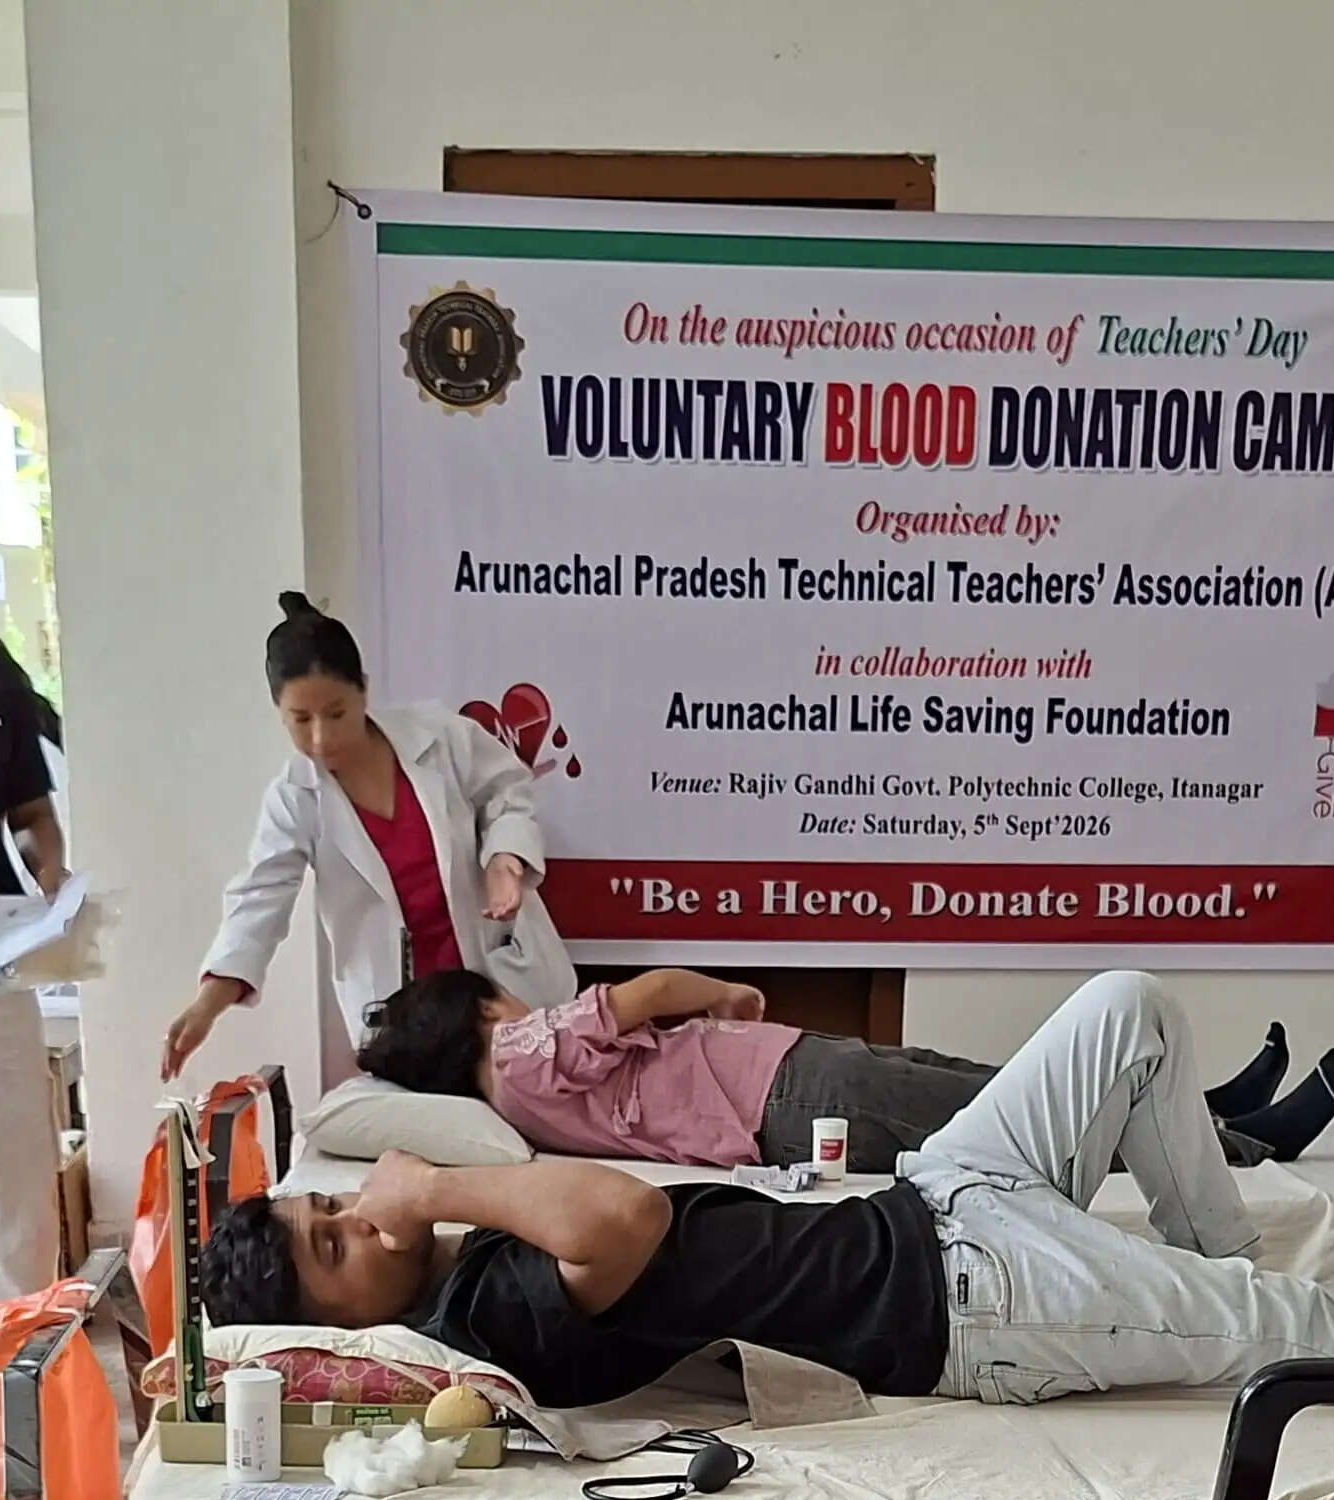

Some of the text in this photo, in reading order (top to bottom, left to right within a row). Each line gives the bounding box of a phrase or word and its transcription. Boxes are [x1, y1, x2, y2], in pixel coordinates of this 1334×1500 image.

[624, 302, 668, 344] On
[679, 304, 725, 345] the
[735, 308, 895, 358] auspicious
[905, 312, 1036, 352] occasion
[1046, 315, 1083, 365] of
[1249, 317, 1309, 369] Day
[541, 374, 814, 463] VOLUNTARY
[824, 382, 977, 466] BLOOD
[988, 386, 1223, 471] DONATION
[855, 500, 1060, 544] Organised by:
[454, 550, 622, 596] Arunachal
[633, 554, 766, 600] Pradesh
[778, 557, 936, 602] Technical
[1113, 563, 1302, 607] Association
[815, 645, 1092, 680] in collaboration with
[665, 691, 1231, 745] Arunachal Life Saving Foundation
[650, 771, 1265, 804] Venue: Rajiv Gandhi Govt. Polytechnic College, Itanagar
[799, 812, 857, 835] Date:
[862, 813, 968, 840] Saturday,
[716, 890, 743, 915] a
[758, 881, 894, 923] Hero,
[909, 883, 1079, 918] Donate
